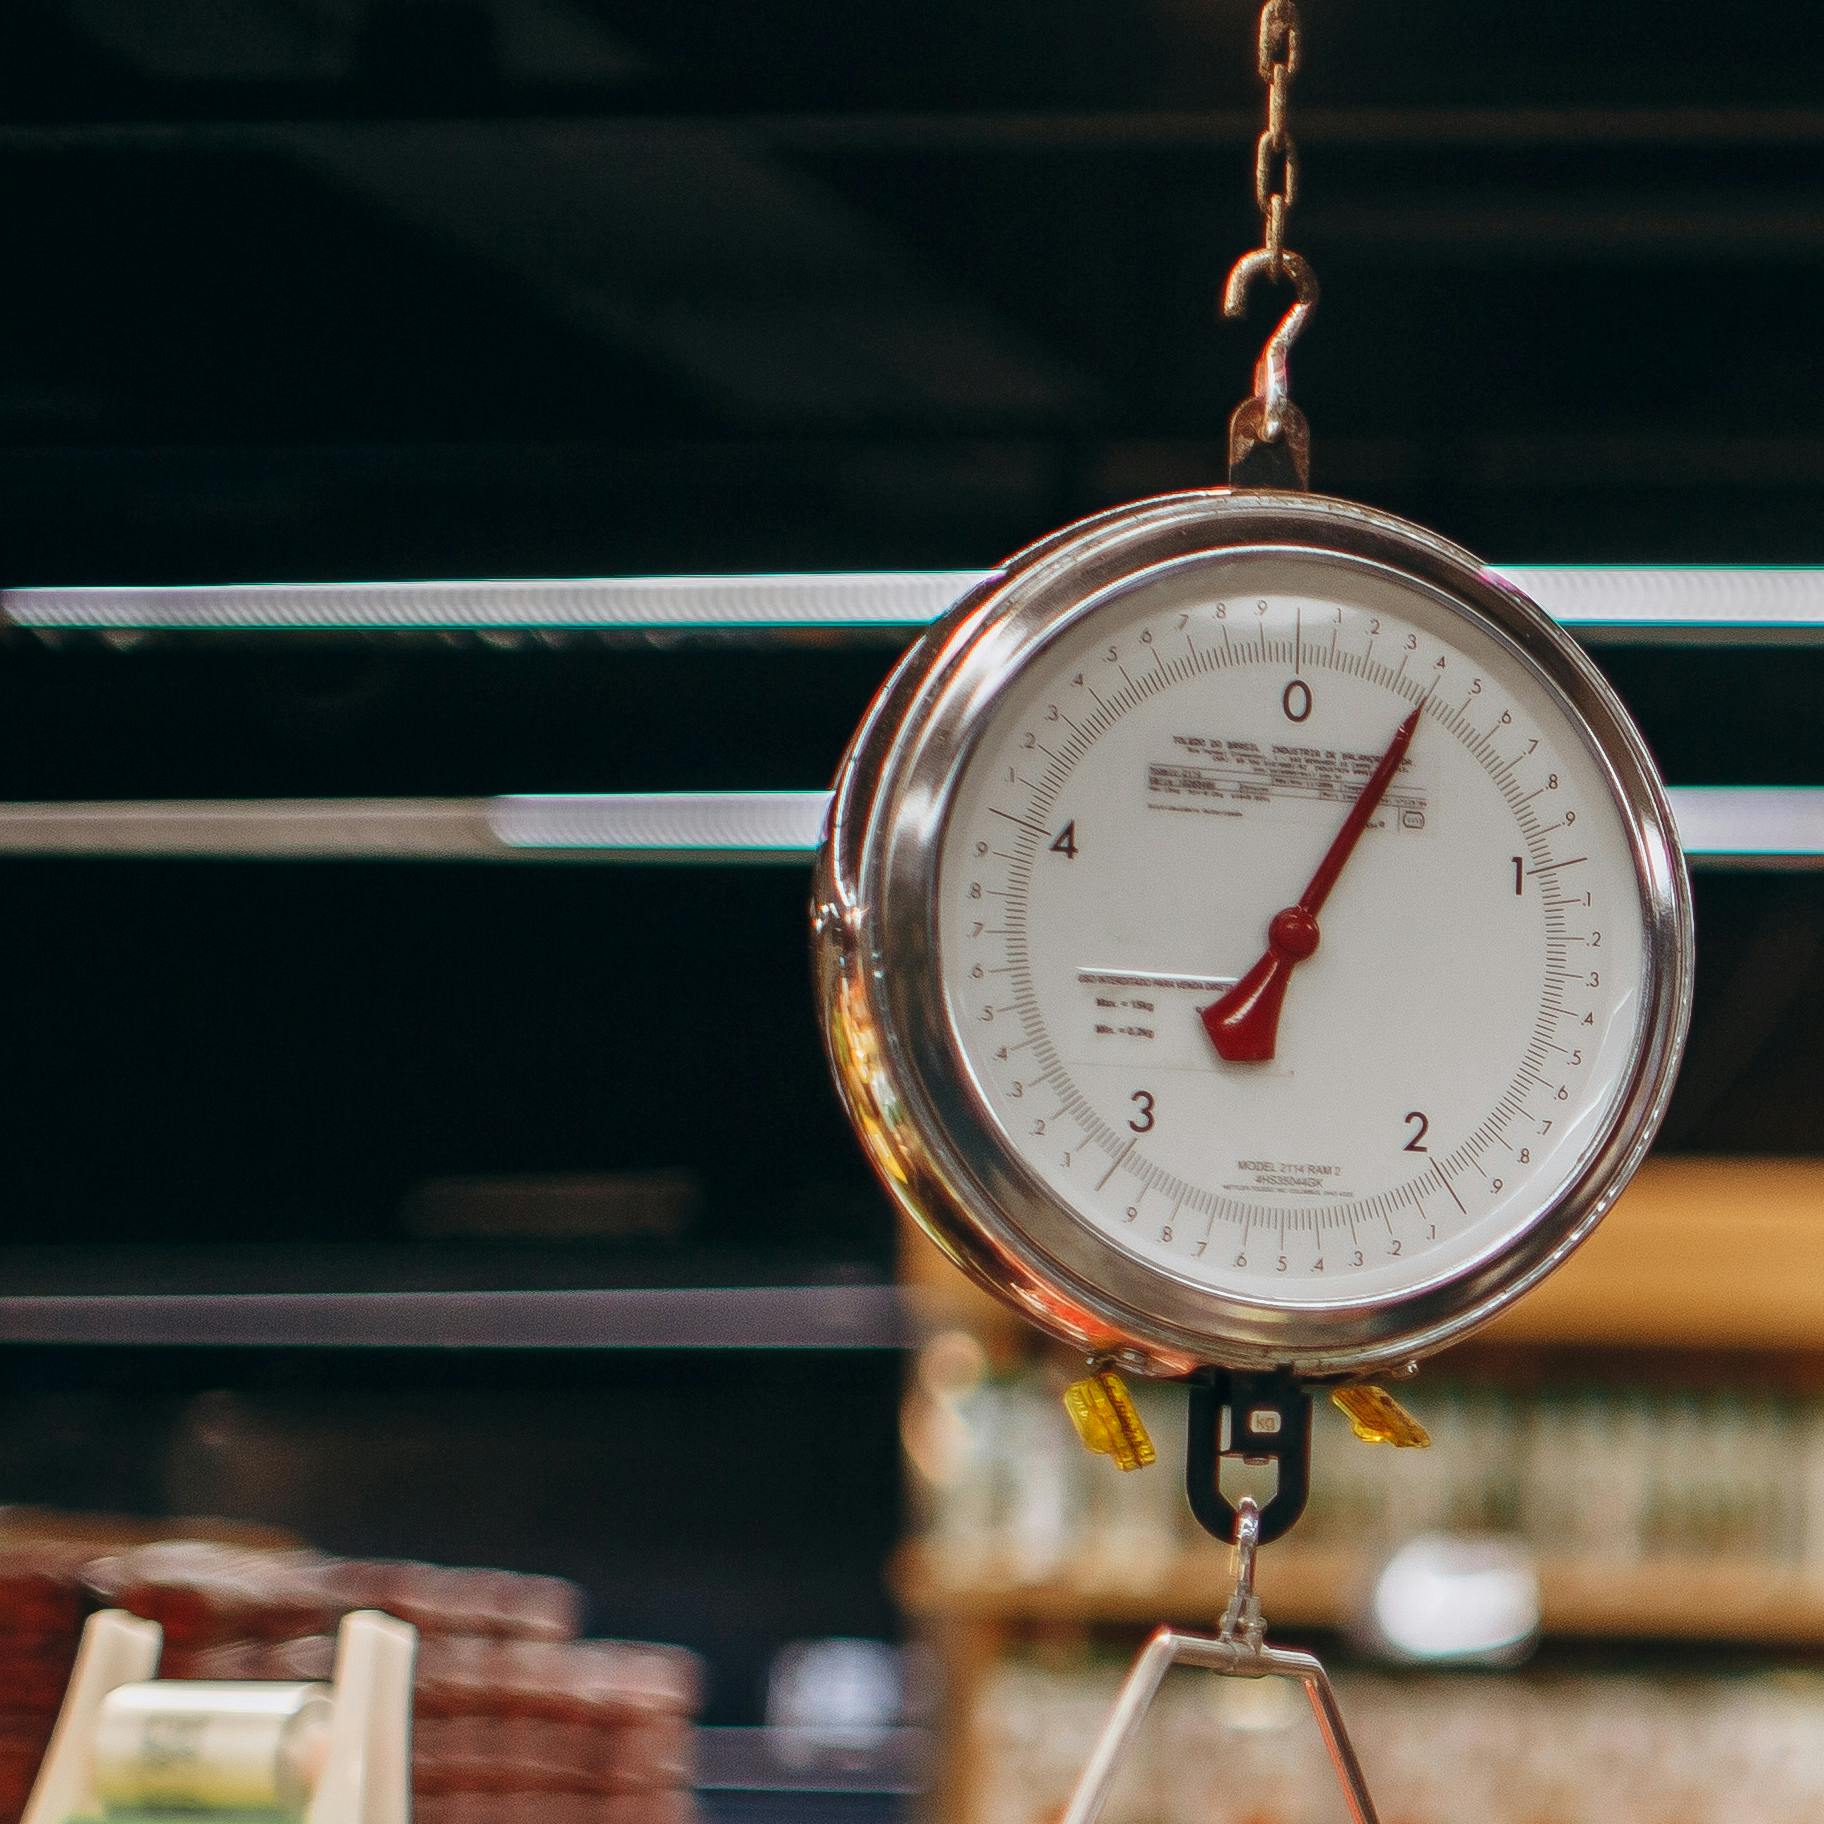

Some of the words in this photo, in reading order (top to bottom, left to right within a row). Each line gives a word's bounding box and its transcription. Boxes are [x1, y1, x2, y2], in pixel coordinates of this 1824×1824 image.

[1214, 603, 1227, 619] .8
[1254, 600, 1268, 616] .9
[1332, 608, 1343, 624] .1
[1174, 613, 1190, 631] .7
[1366, 619, 1381, 635] .2
[1404, 634, 1417, 650] .3
[1434, 656, 1446, 669] .4
[1467, 678, 1482, 695] .5
[1283, 679, 1312, 723] 0
[1497, 709, 1512, 725] .6
[1523, 738, 1539, 756] .7
[1545, 773, 1558, 790] .8
[1562, 811, 1576, 827] .9
[1050, 819, 1079, 860] 4
[1511, 856, 1524, 895] 1
[1582, 892, 1591, 907] .1
[1586, 931, 1601, 947] .2
[1586, 972, 1600, 988] .3
[1580, 1012, 1593, 1026] .4
[1566, 1050, 1582, 1066] .5
[1553, 1085, 1569, 1101] .6
[1128, 1090, 1156, 1133] 3
[1403, 1111, 1430, 1152] 2
[1536, 1120, 1553, 1136] .7
[1516, 1147, 1530, 1164] .8
[1237, 1160, 1277, 1172] MODEL
[1307, 1164, 1332, 1175] RAM
[1490, 1178, 1504, 1194] .9
[1121, 1206, 1138, 1223] .9
[1157, 1225, 1174, 1242] .8
[1426, 1224, 1437, 1240] .1
[1190, 1241, 1207, 1257] .7
[1387, 1239, 1402, 1255] .2
[1232, 1251, 1248, 1268] .6
[1310, 1257, 1325, 1273] .4
[1348, 1250, 1365, 1267] .3
